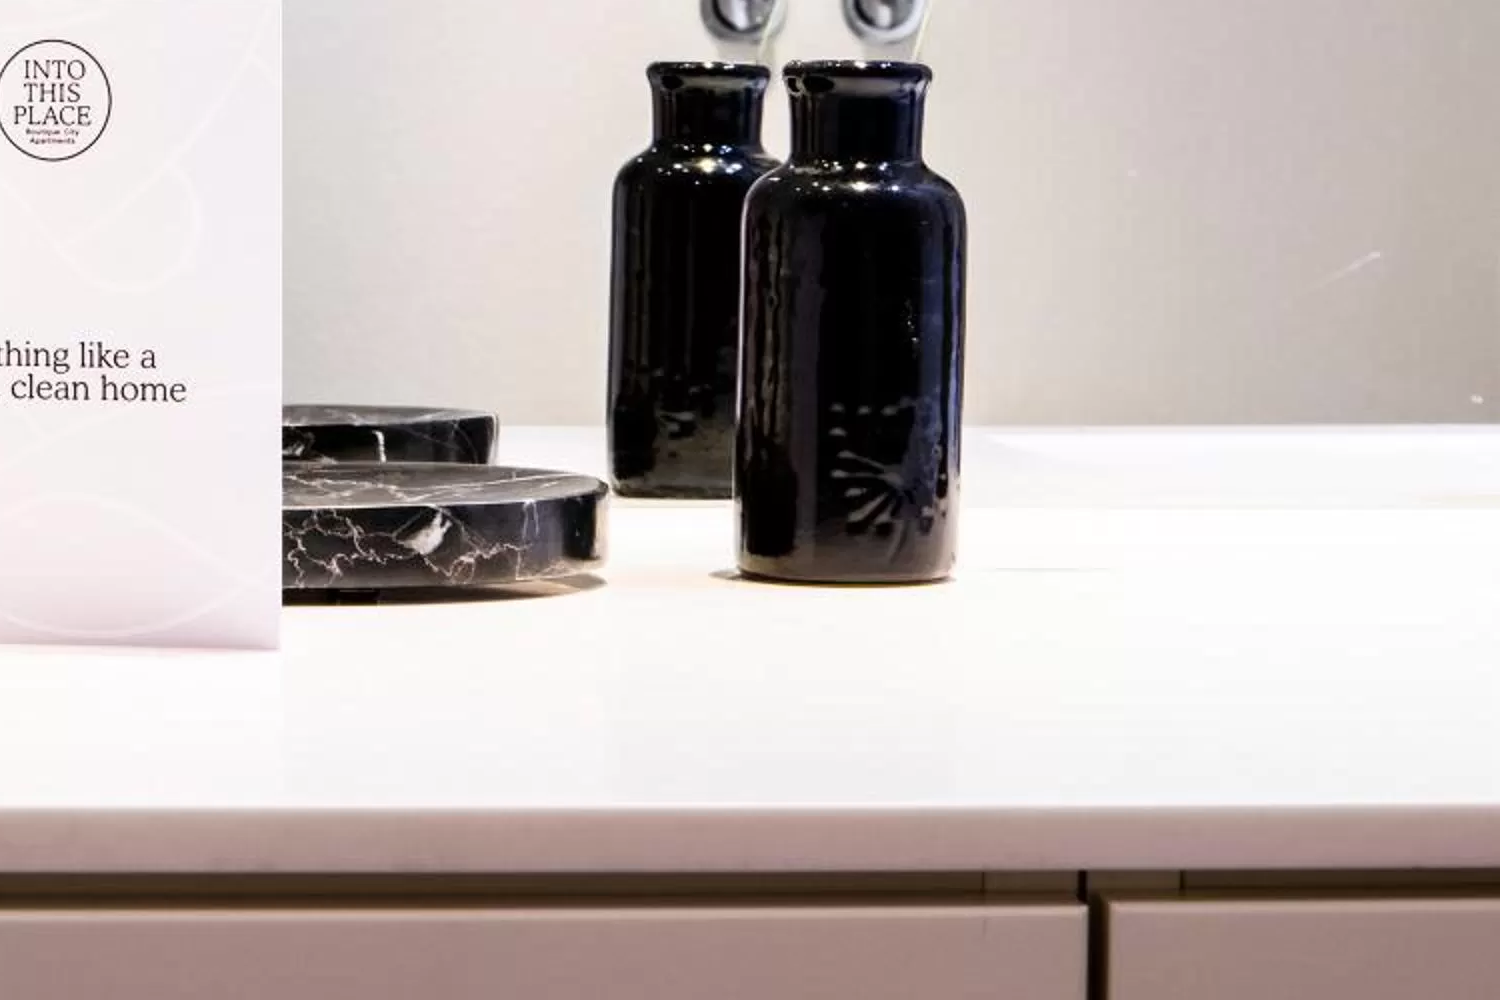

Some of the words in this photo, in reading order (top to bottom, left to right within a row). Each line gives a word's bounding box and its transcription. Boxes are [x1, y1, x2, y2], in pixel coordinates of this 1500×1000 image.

[24, 59, 86, 80] INTO
[23, 82, 81, 103] THIS
[13, 105, 92, 126] PLACE
[26, 128, 61, 137] Boutique
[63, 127, 79, 137] City
[29, 137, 75, 145] Apartments
[79, 341, 130, 369] like
[140, 348, 157, 369] a
[11, 373, 90, 401] clean
[101, 375, 188, 403] home
